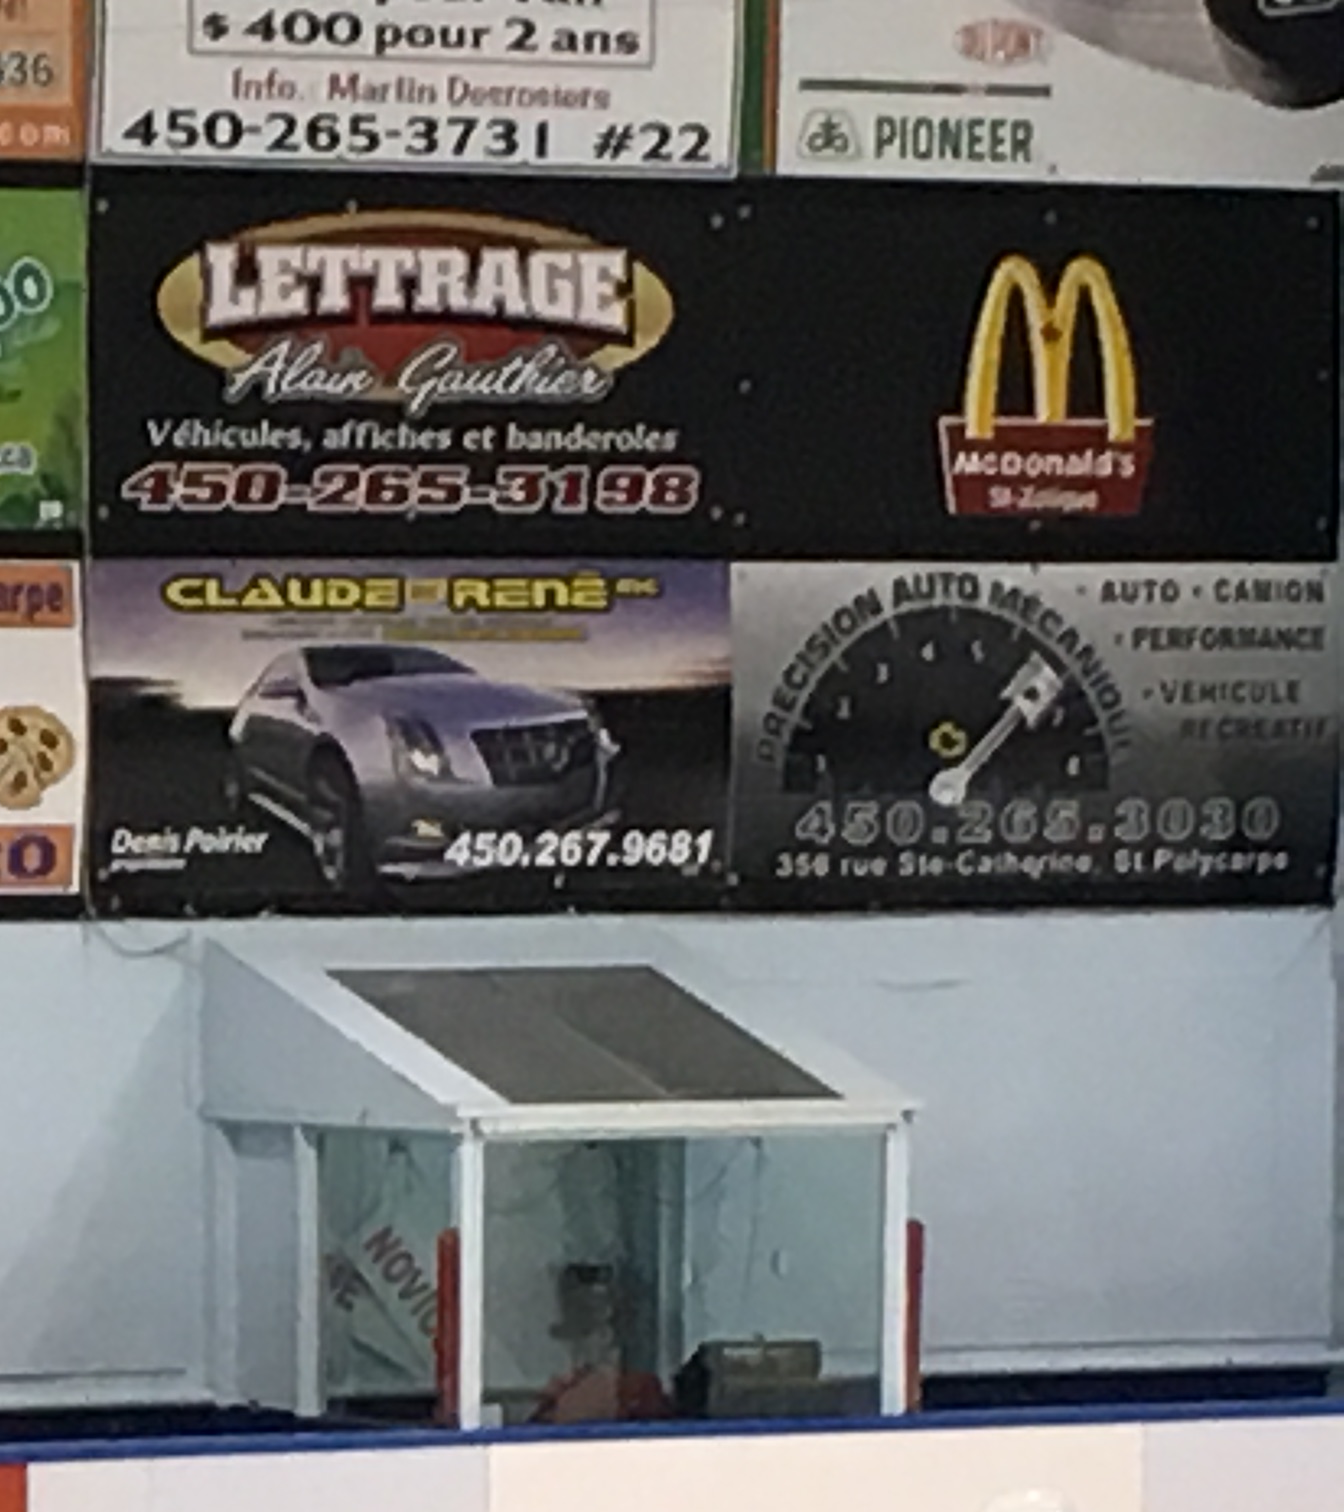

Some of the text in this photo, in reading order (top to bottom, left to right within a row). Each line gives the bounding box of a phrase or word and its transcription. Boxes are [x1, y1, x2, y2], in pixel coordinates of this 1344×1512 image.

[243, 10, 362, 46] 400
[374, 22, 490, 57] pour
[505, 18, 539, 52] 2
[550, 28, 640, 55] ans
[122, 108, 712, 162] 450-265-3731 #22
[874, 115, 1034, 163] PIONEER
[203, 242, 630, 335] LETTRAGE
[224, 335, 612, 418] Alain Gauthier
[146, 420, 679, 452] Véhicules, affiches et banderoles
[953, 448, 1135, 478] McDonald's
[120, 462, 701, 514] 450-265-3198
[164, 576, 403, 611] CLAUDE
[891, 571, 981, 609] AUTO
[1101, 578, 1326, 604] AUTO CAMION
[1131, 626, 1327, 652] PERFORMANCE
[443, 828, 714, 868] 450.267.9681
[840, 855, 888, 876] rue
